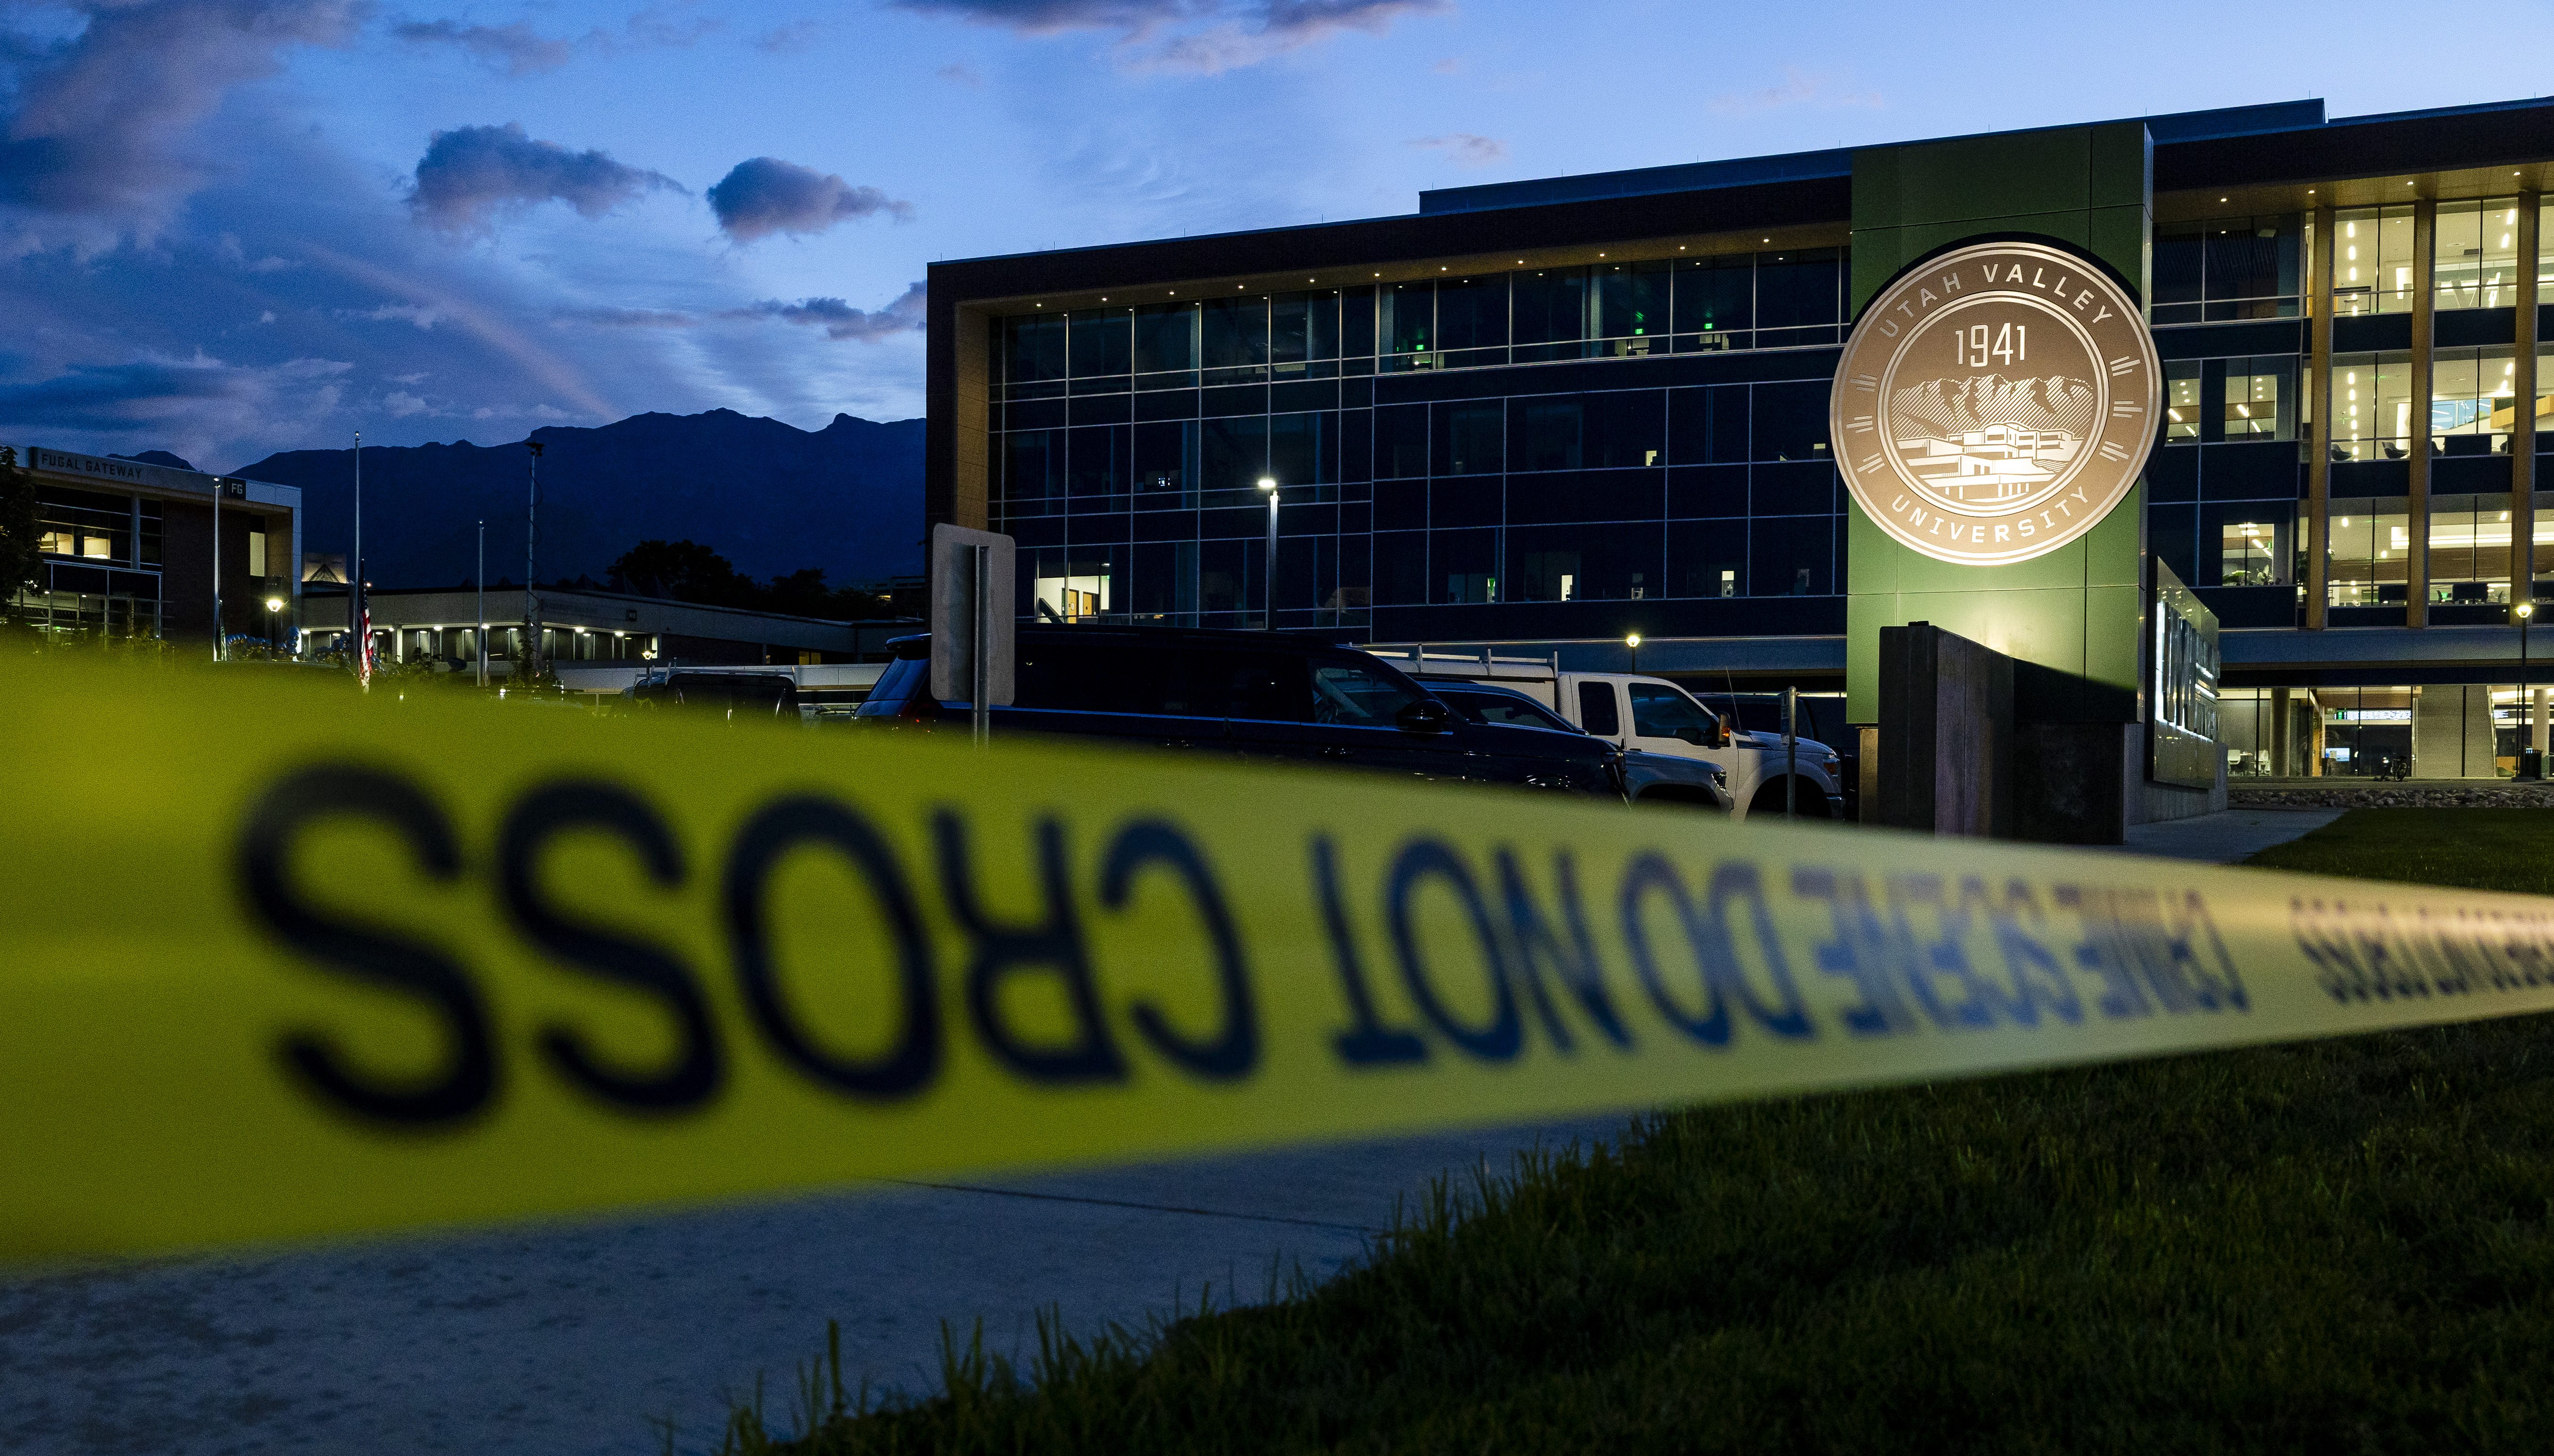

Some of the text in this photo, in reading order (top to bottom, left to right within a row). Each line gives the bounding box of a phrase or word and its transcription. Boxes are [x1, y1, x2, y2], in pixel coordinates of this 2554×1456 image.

[1879, 263, 2113, 338] UTAH VALLEY
[1955, 322, 2026, 367] 1941
[42, 453, 142, 479] FUGAL GATEWAY
[231, 483, 243, 494] FG
[1892, 485, 2089, 544] UNIVERSITY
[237, 761, 1256, 1129] CROSS
[1309, 831, 1634, 1067] NOT
[1619, 852, 1813, 1045] DO
